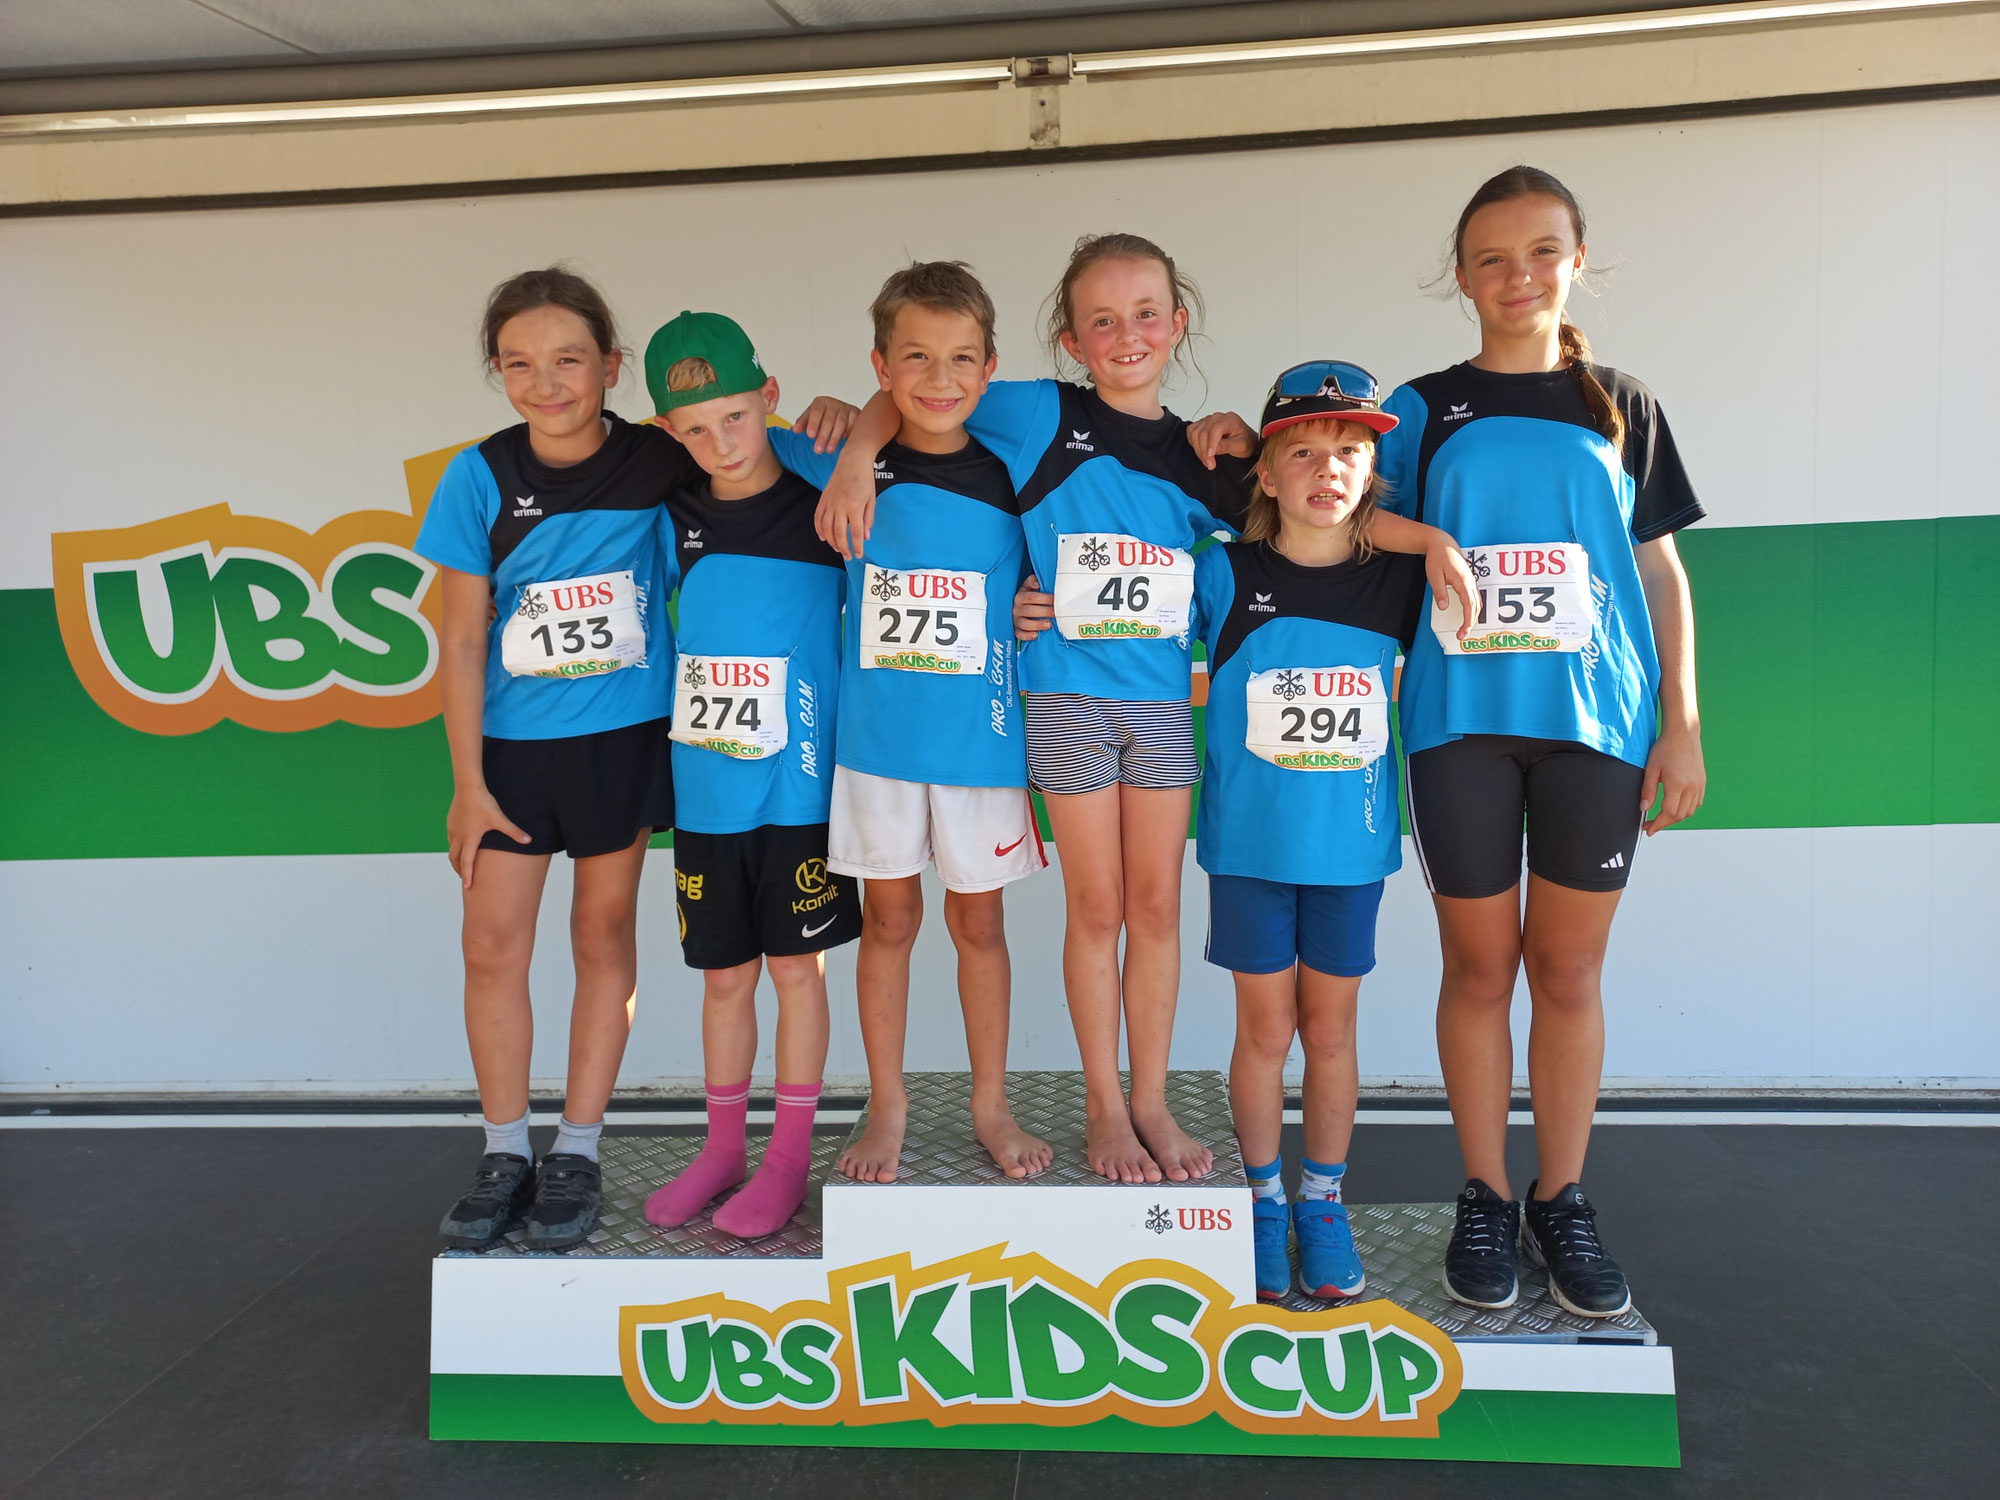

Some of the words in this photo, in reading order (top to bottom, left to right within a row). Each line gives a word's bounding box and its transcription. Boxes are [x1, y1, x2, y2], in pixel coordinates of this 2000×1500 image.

[1443, 411, 1473, 421] erima
[1066, 440, 1094, 452] erima
[874, 469, 894, 479] ima
[513, 508, 543, 517] erima
[683, 540, 703, 549] erima
[1115, 541, 1174, 567] UBS
[1496, 549, 1567, 577] UBS
[551, 581, 614, 612] UBS
[908, 574, 967, 601] UBS
[1097, 576, 1150, 612] 46
[1248, 602, 1277, 613] erima
[91, 551, 431, 695] UBS
[530, 615, 614, 657] 133
[879, 607, 959, 646] 275
[1080, 627, 1102, 636] UBS
[1103, 621, 1139, 635] KIDS
[1139, 627, 1160, 636] CUP
[1462, 640, 1487, 650] UBS
[1489, 633, 1531, 648] KIDS
[1532, 638, 1558, 648] CUP
[558, 661, 597, 676] KIDS
[599, 660, 619, 671] CUP
[877, 657, 898, 667] UBS
[899, 654, 937, 668] KIDS
[937, 660, 959, 671] CUP
[990, 637, 1005, 686] CAM
[709, 663, 770, 687] UBS
[1312, 671, 1372, 697] UBS
[690, 695, 761, 732] 274
[798, 678, 815, 728] CAM
[990, 698, 1007, 737] PRO
[1280, 707, 1362, 744] 294
[707, 740, 739, 755] KIDS
[740, 745, 763, 756] CUP
[801, 740, 819, 778] PRO
[1277, 756, 1300, 767] UBS
[1302, 754, 1341, 767] KIDS
[1341, 757, 1362, 767] CUP
[1364, 798, 1376, 834] PRO
[791, 884, 839, 914] Komit
[1176, 1208, 1233, 1231] UBS
[640, 1320, 837, 1405] UBS
[852, 1281, 1205, 1402] KIDS
[1223, 1328, 1438, 1415] CUP
